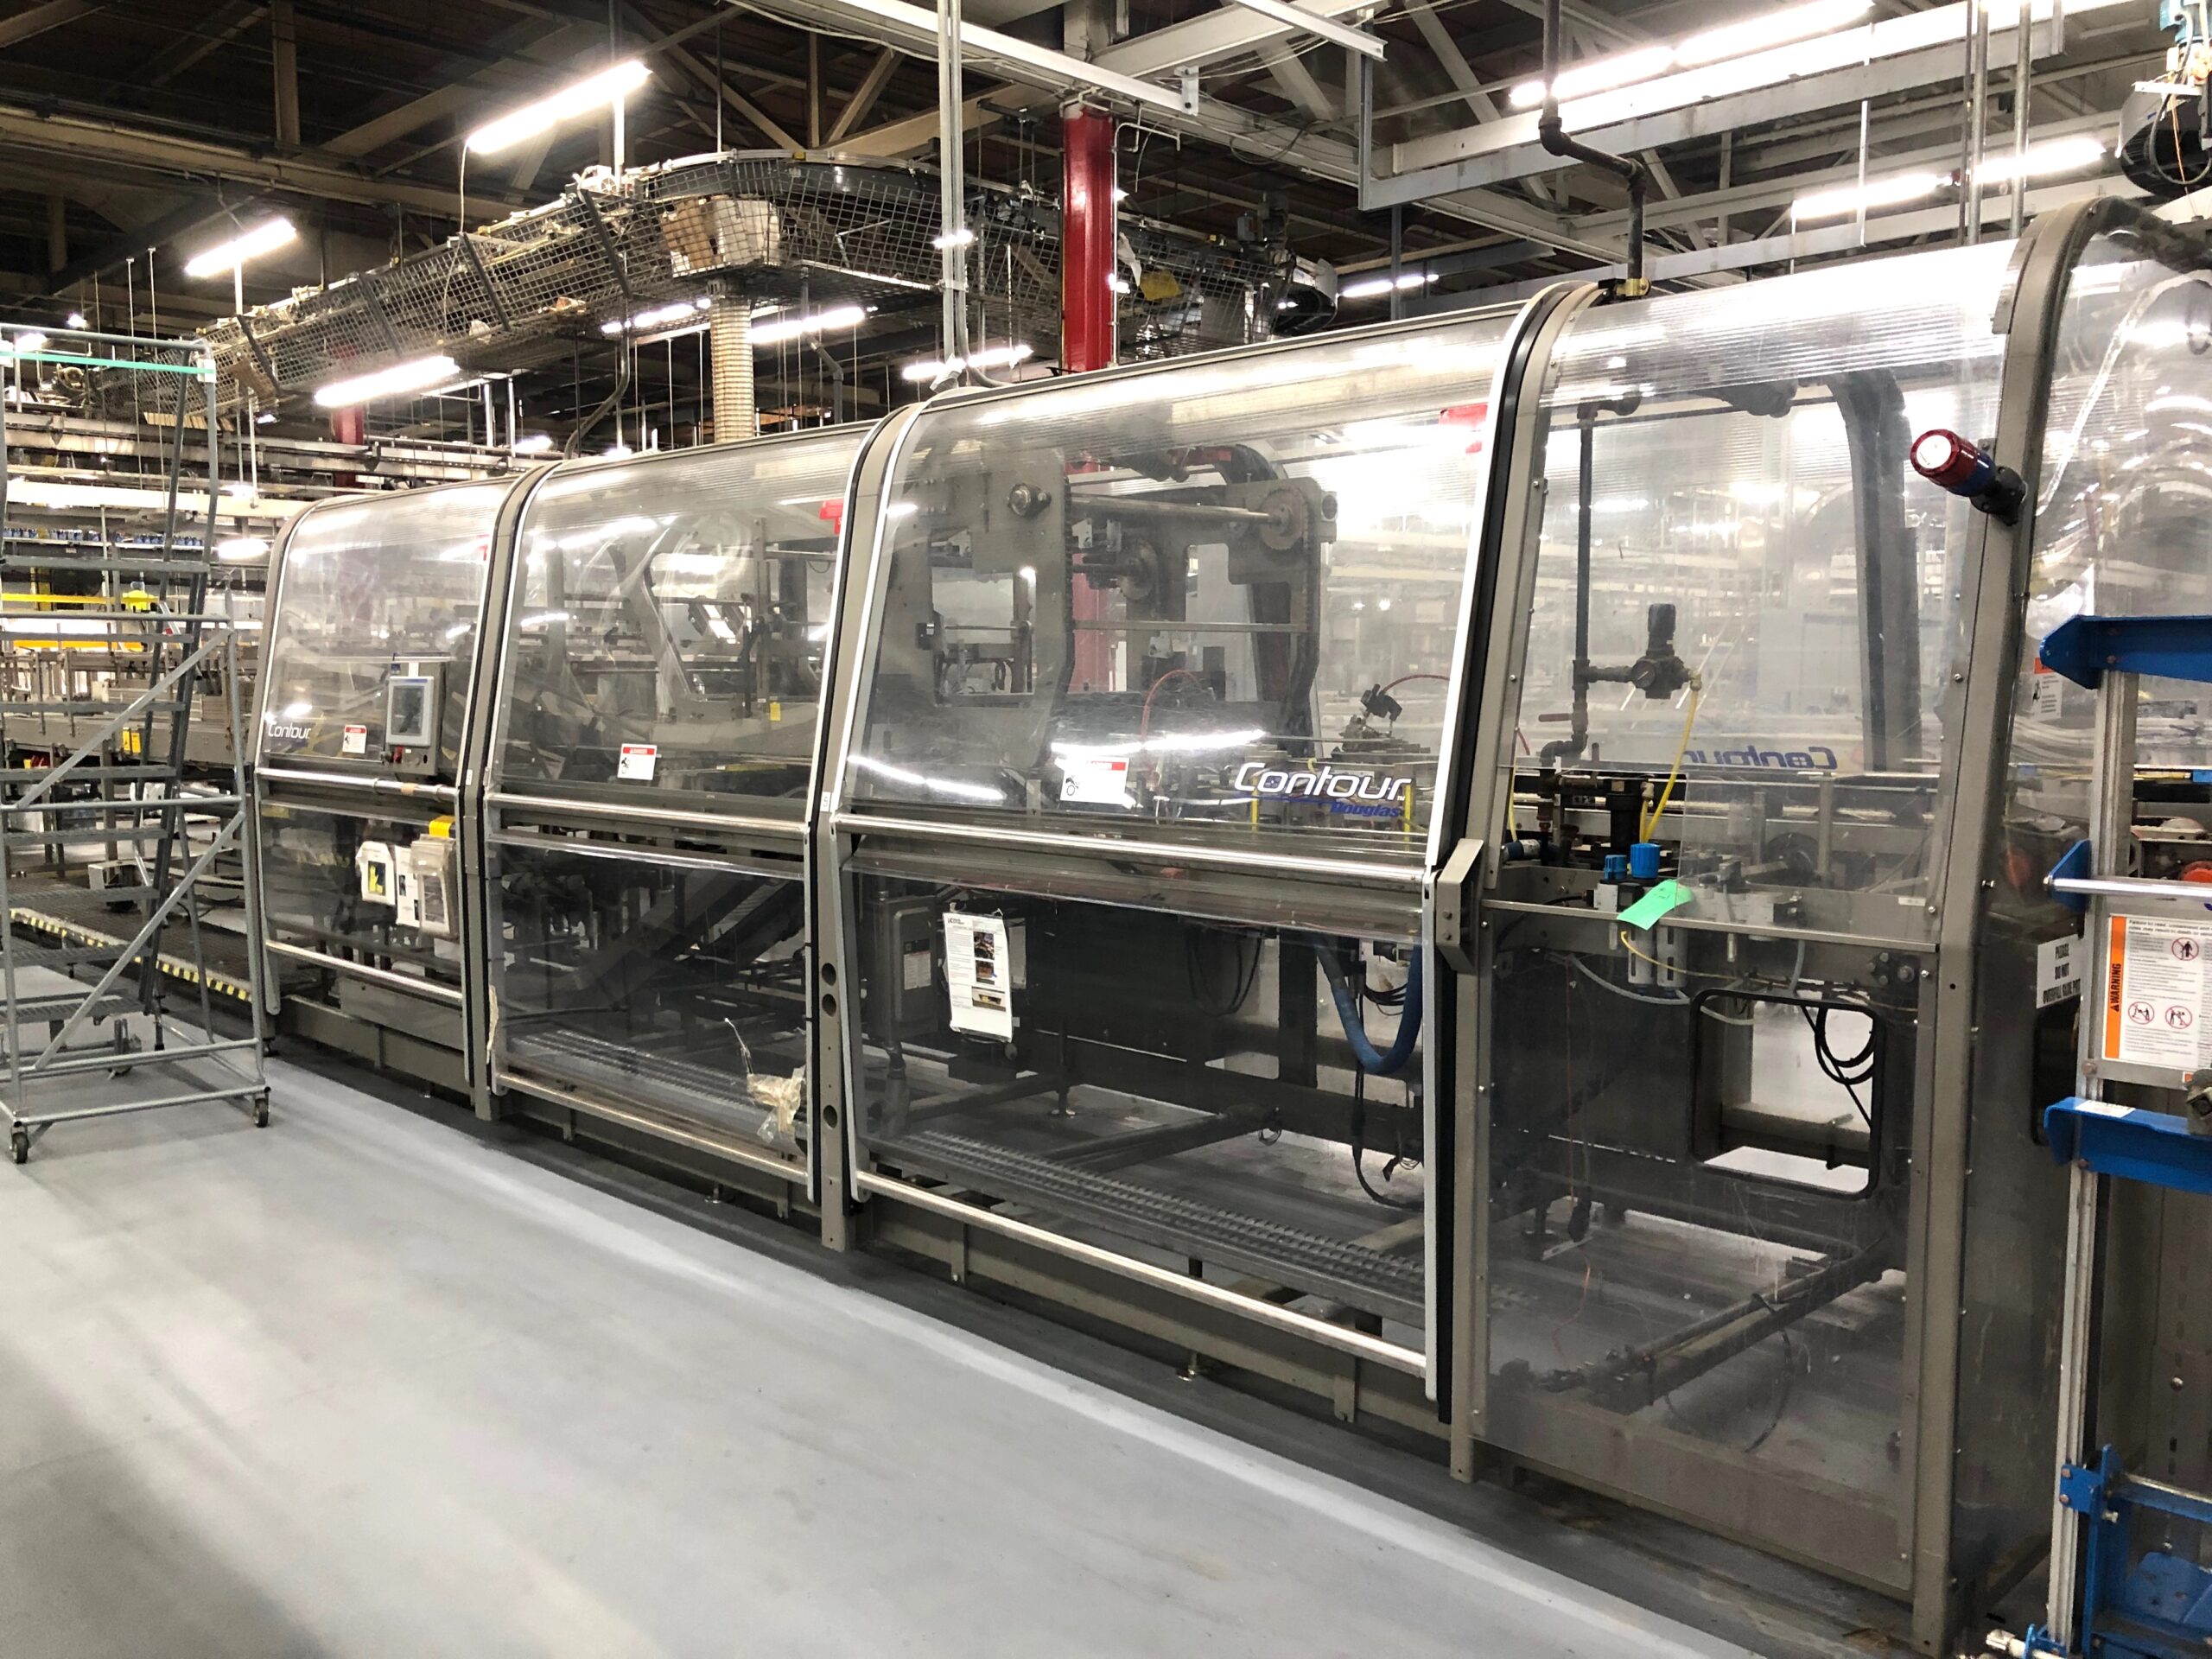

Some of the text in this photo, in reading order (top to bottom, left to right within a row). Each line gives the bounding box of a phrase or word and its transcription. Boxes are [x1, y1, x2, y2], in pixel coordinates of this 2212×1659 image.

[267, 721, 312, 740] Contour
[1234, 762, 1412, 801] Contour
[1330, 801, 1401, 817] Douglas
[2110, 963, 2121, 1003] WARNING
